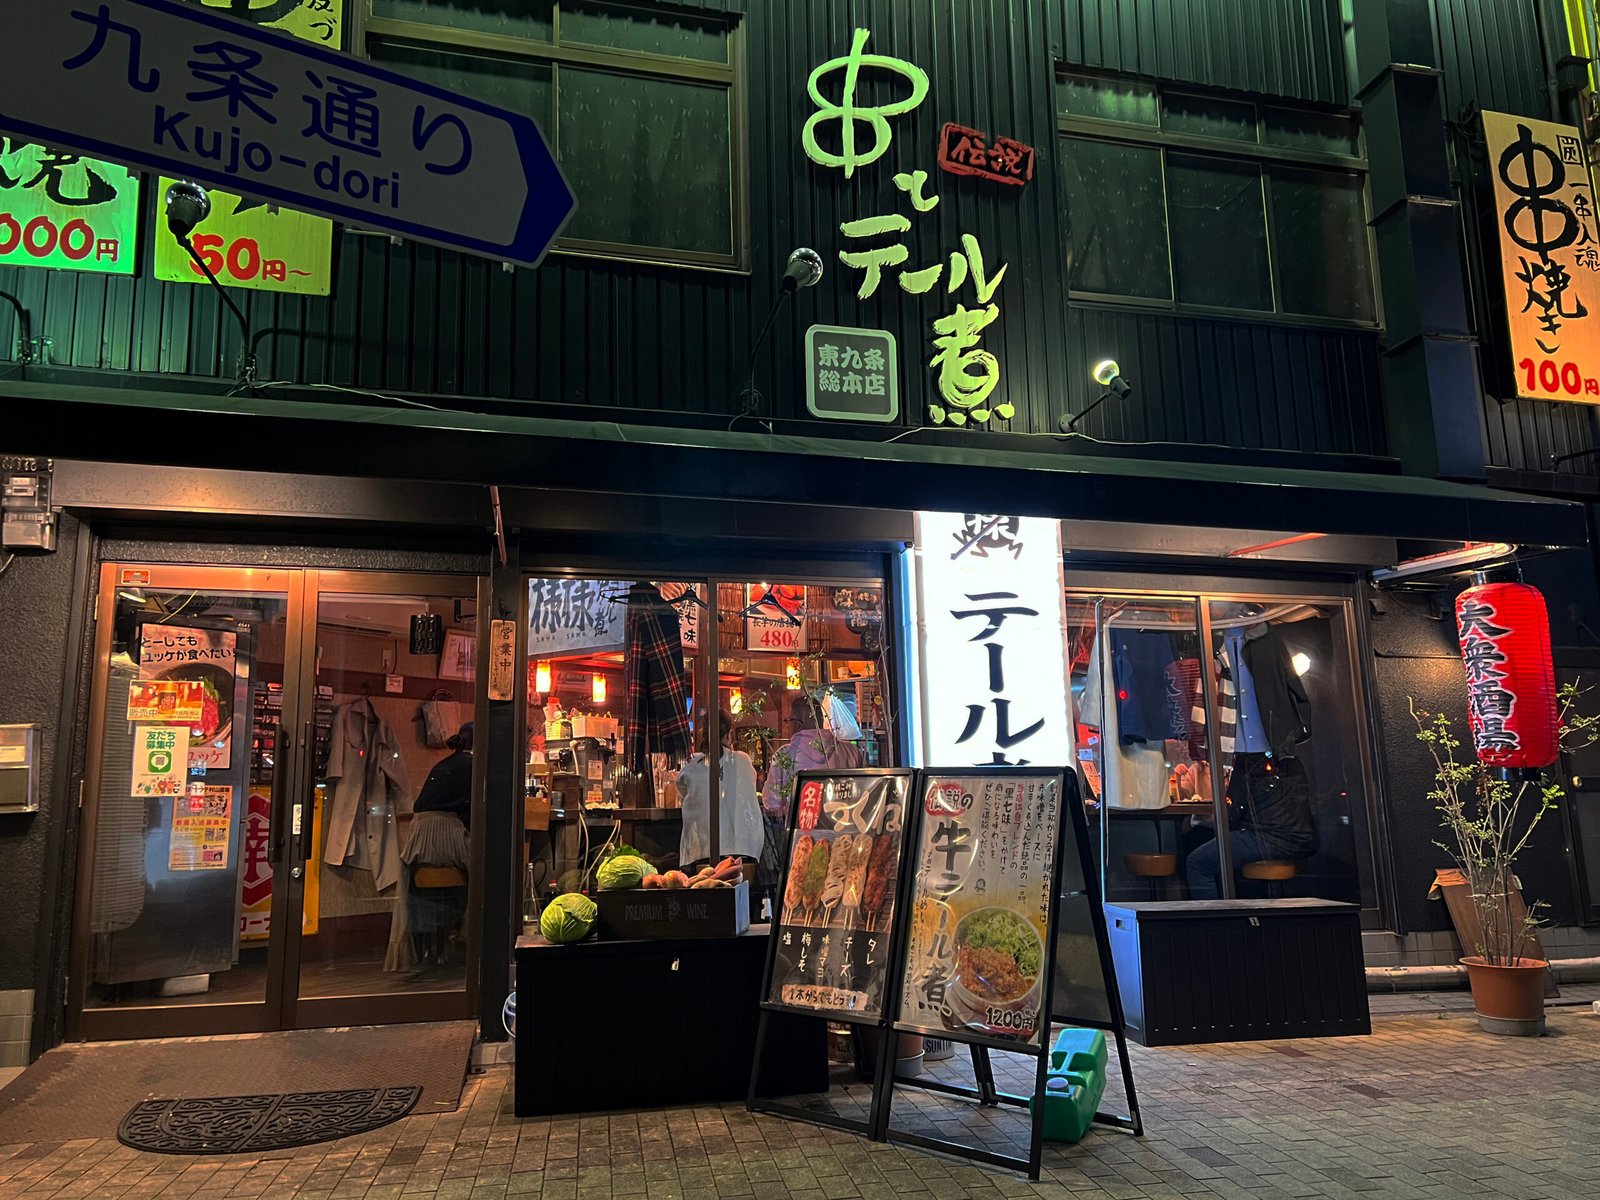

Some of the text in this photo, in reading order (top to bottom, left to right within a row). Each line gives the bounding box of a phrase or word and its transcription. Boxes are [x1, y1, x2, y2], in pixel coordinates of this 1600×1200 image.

[62, 5, 473, 175] 九条通り
[153, 105, 400, 209] Kujo-dori
[1498, 123, 1588, 354] 串焼き
[1568, 182, 1600, 271] 一串入魂
[818, 343, 886, 371] 東九条
[1519, 357, 1600, 397] 100円
[818, 369, 886, 396] 総本店
[500, 625, 513, 672] 営業中
[949, 591, 1046, 766] テール
[1458, 602, 1522, 751] 大衆酒場
[146, 731, 176, 741] 友だち
[799, 785, 817, 830] 名物
[625, 903, 709, 921] PREMIUM WINE
[798, 932, 812, 973] 梅しそ
[840, 936, 854, 977] チーズ
[865, 938, 877, 966] タレ
[986, 1005, 1035, 1032] 1200円
